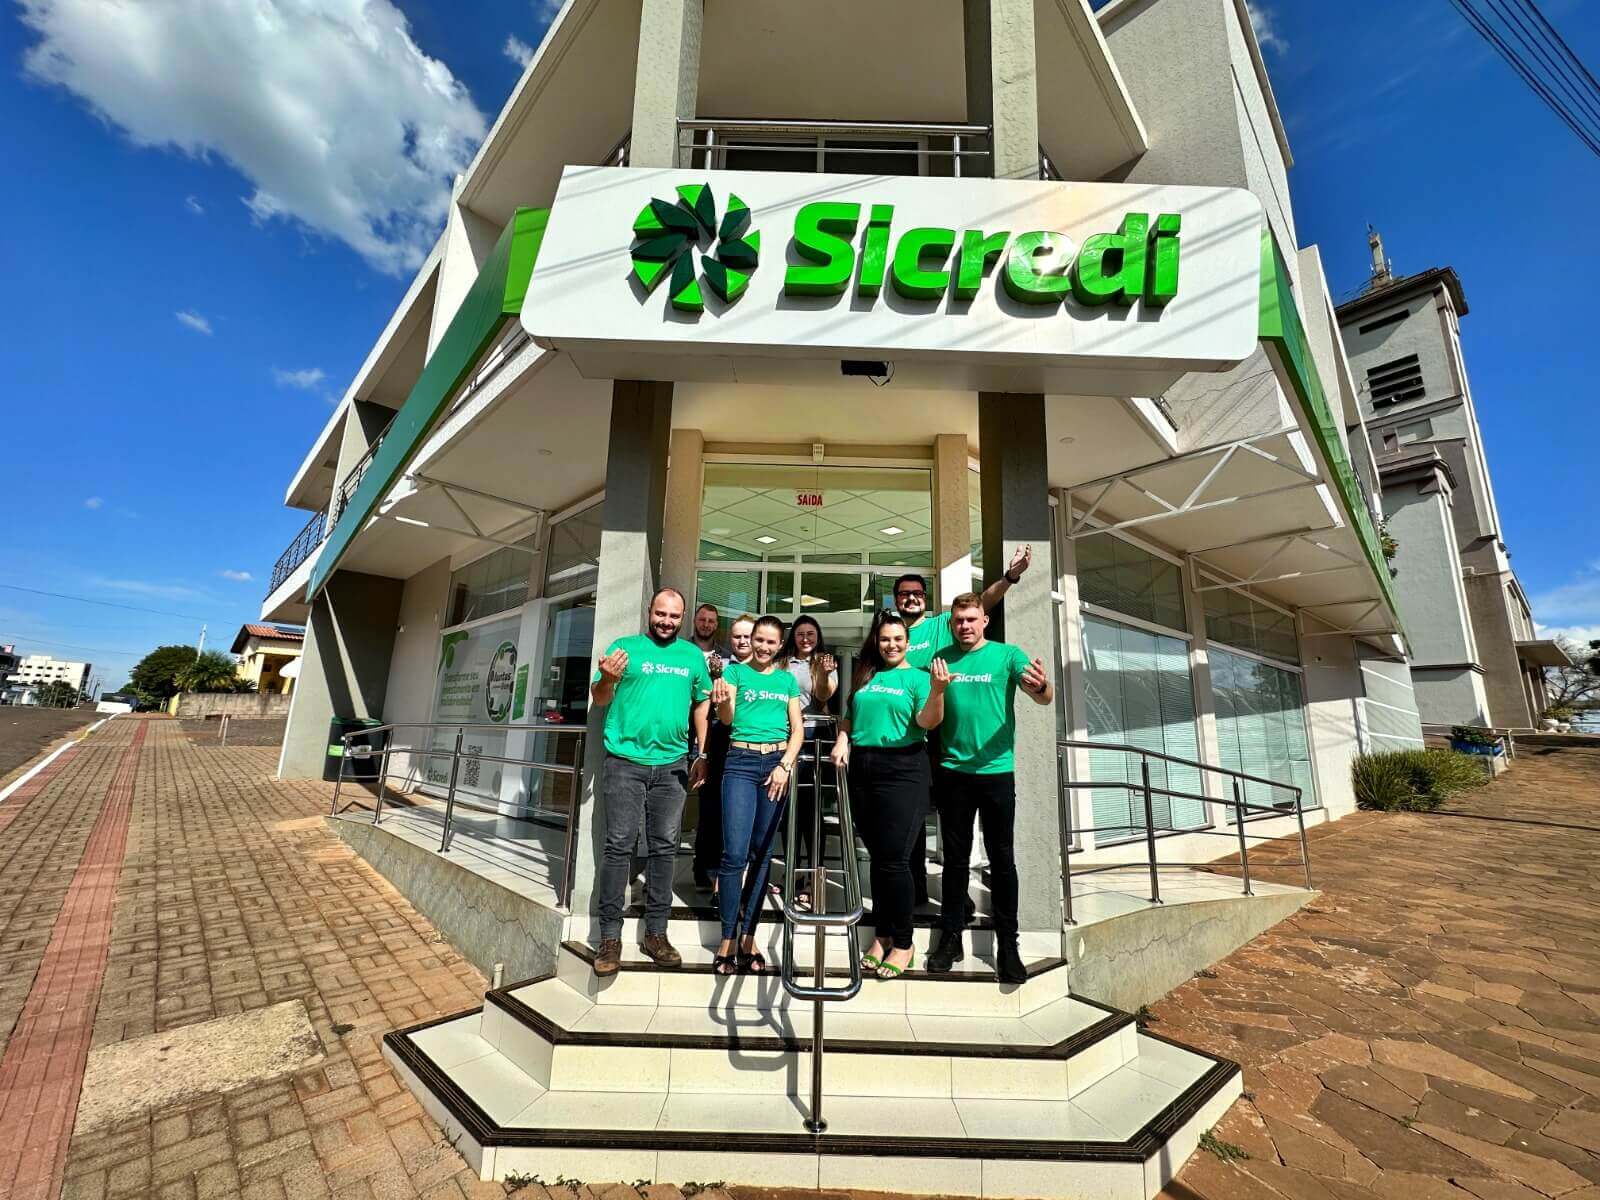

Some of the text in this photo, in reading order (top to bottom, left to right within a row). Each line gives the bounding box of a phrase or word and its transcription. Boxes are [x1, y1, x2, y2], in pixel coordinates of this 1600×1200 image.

[784, 202, 1182, 306] Sicredi
[655, 664, 689, 677] Sicredi
[954, 672, 992, 683] Sicredi
[870, 684, 904, 696] Sicredi
